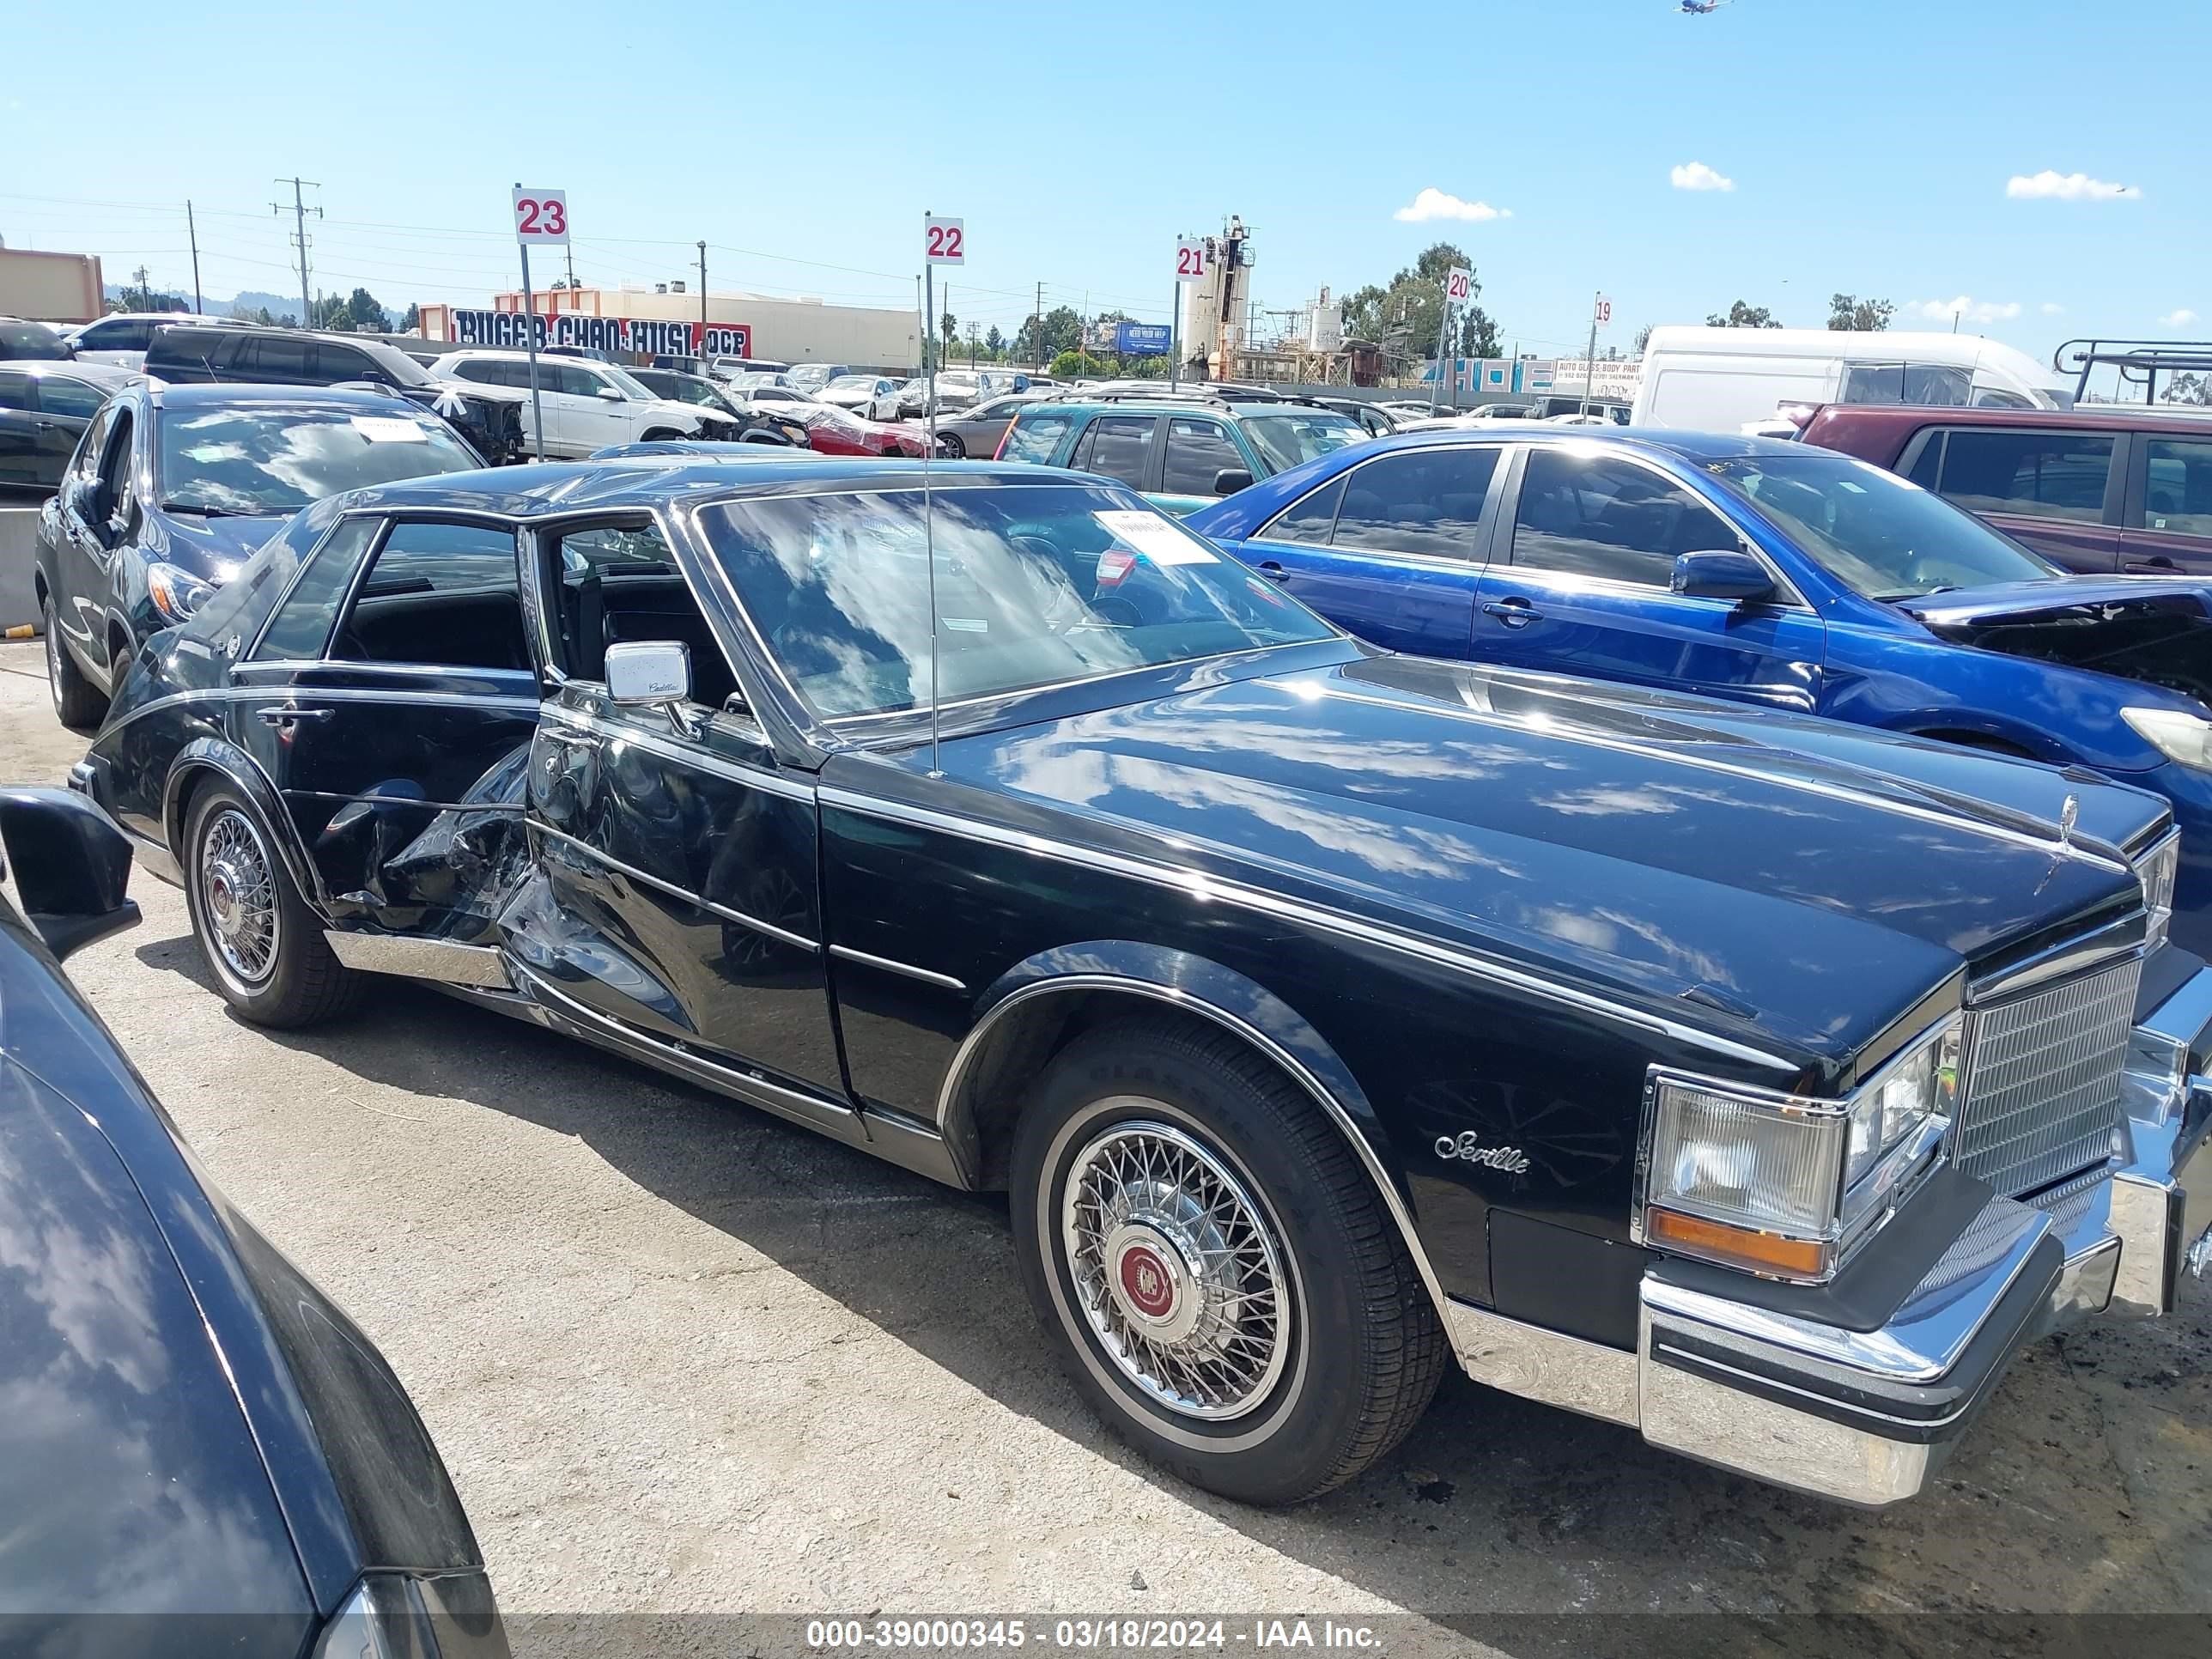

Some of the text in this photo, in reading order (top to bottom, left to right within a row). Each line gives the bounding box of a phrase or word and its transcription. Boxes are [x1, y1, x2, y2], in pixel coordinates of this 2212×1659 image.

[517, 198, 566, 234] 23
[927, 226, 963, 258] 22
[1177, 247, 1204, 276] 21
[1449, 273, 1468, 298] 20
[1595, 301, 1611, 322] 19
[1154, 330, 1167, 339] HELP
[1559, 362, 1577, 371] AUTO
[1434, 1130, 1530, 1174] Seville
